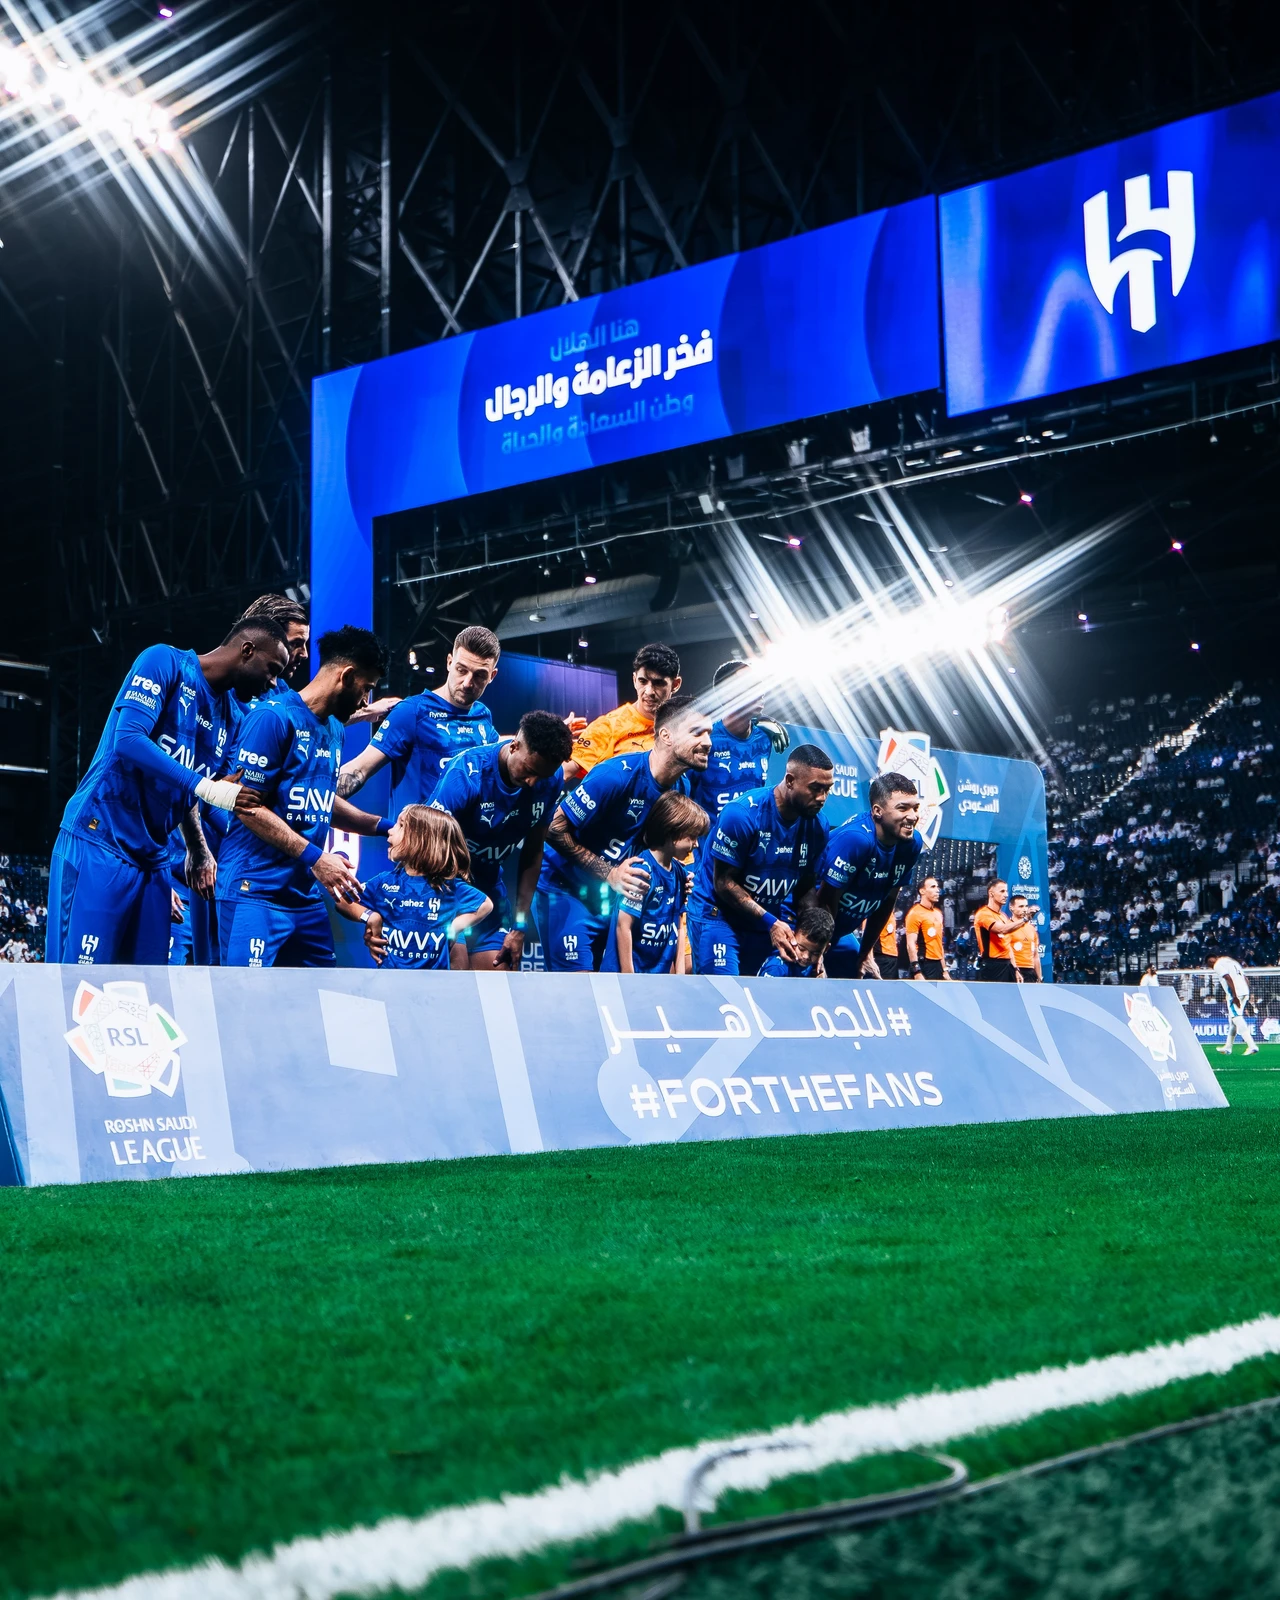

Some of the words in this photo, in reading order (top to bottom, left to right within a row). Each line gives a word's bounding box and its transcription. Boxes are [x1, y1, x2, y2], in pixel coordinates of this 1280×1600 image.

[610, 318, 640, 344] هنا
[550, 324, 607, 362] الهلال
[663, 328, 714, 381] فخر
[572, 343, 662, 396] الزعامة
[485, 372, 570, 423] والرجال
[649, 393, 695, 421] وطن
[566, 399, 646, 440] السعادة
[131, 674, 162, 696] tree
[131, 690, 157, 706] SANABIL
[238, 748, 269, 768] tree
[834, 764, 858, 778] SAUDI
[957, 779, 980, 795] روشن
[979, 784, 999, 799] دوري
[575, 785, 597, 811] tree
[958, 799, 1000, 817] السعودي
[286, 812, 324, 823] GAMES
[716, 827, 739, 848] tree
[834, 856, 857, 873] tree
[399, 898, 425, 909] jahez
[600, 986, 913, 1055] #للجماهير
[1142, 1020, 1160, 1032] RSL
[106, 1027, 149, 1047] RSL
[628, 1071, 944, 1119] #FORTHEFANS
[104, 1119, 155, 1134] ROSHN
[156, 1115, 198, 1132] SAUDI
[109, 1135, 207, 1166] LEAGUE
